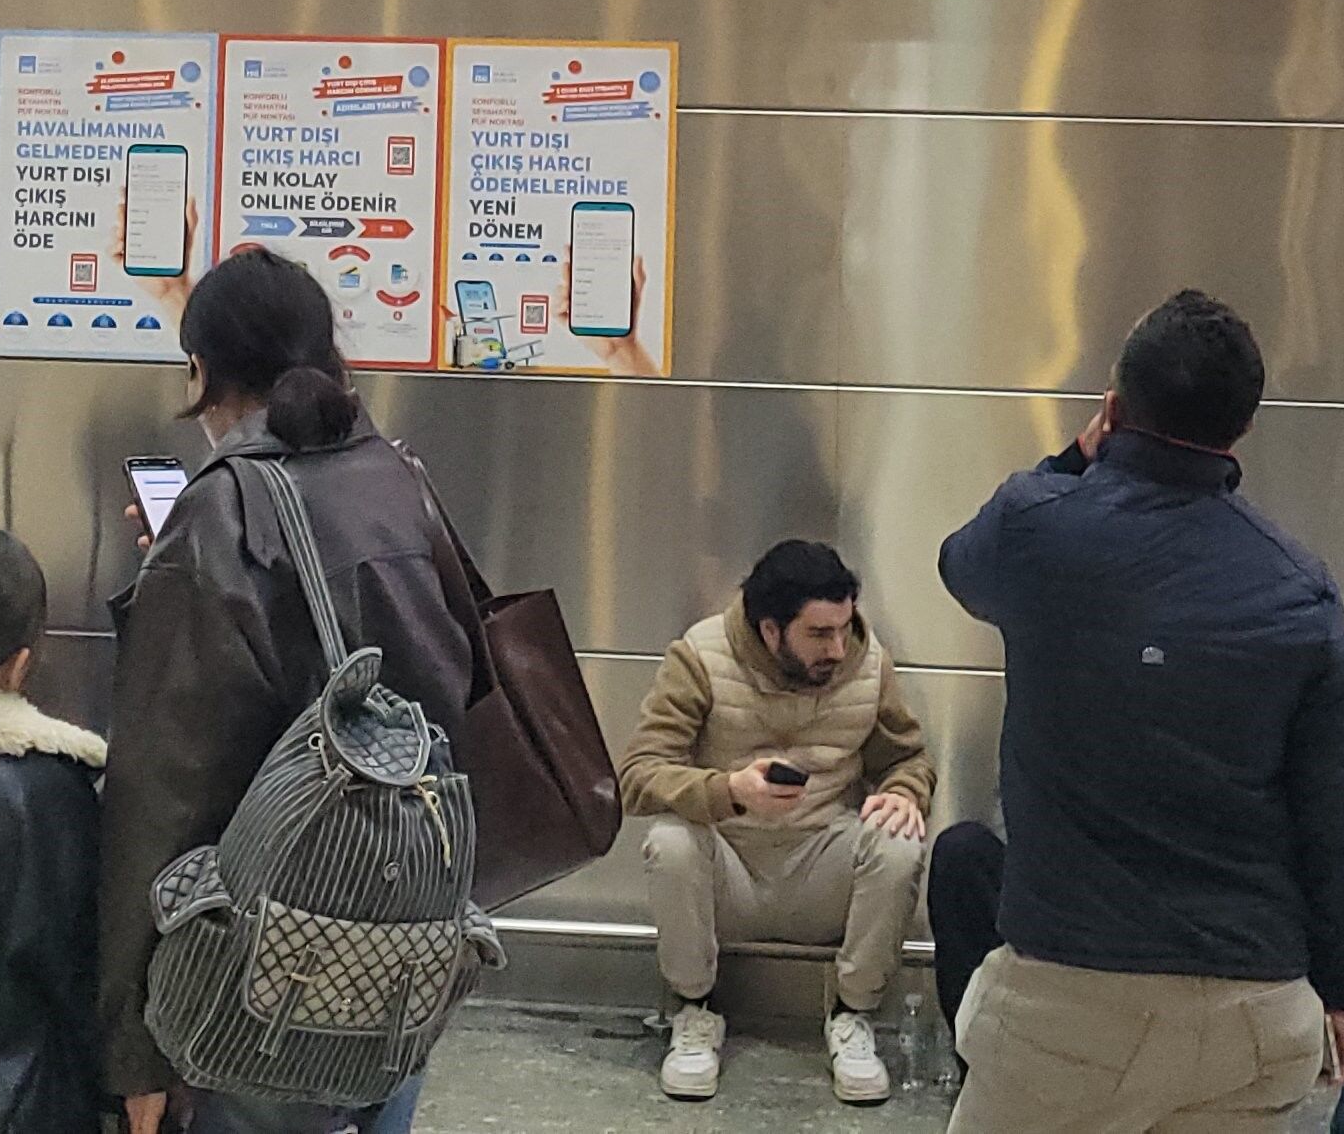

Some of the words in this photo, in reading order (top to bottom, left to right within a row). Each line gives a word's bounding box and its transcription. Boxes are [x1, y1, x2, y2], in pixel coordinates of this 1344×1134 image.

[472, 98, 516, 106] KONFORLU
[17, 118, 165, 139] HAVALİMANINA
[243, 126, 297, 142] YURT
[301, 128, 339, 147] DIŞI
[16, 143, 123, 161] GELMEDEN
[472, 131, 526, 149] YURT
[530, 133, 569, 152] DIŞI
[242, 149, 294, 168] ÇIKIŞ
[299, 150, 360, 167] HARCI
[471, 154, 523, 175] ÇIKIŞ
[529, 156, 591, 173] HARCI
[16, 165, 68, 182] YURT
[73, 167, 111, 187] DIŞI
[242, 171, 267, 187] EN
[273, 173, 338, 188] KOLAY
[470, 171, 628, 196] ÖDEMELERİNDE
[15, 188, 66, 208] ÇIKIŞ
[241, 194, 316, 210] ONLINE
[321, 192, 397, 213] ÖDENİR
[469, 197, 516, 216] YENİ
[14, 210, 95, 227] HARCINI
[14, 228, 54, 249] ÖDE
[469, 219, 542, 240] DÖNEM
